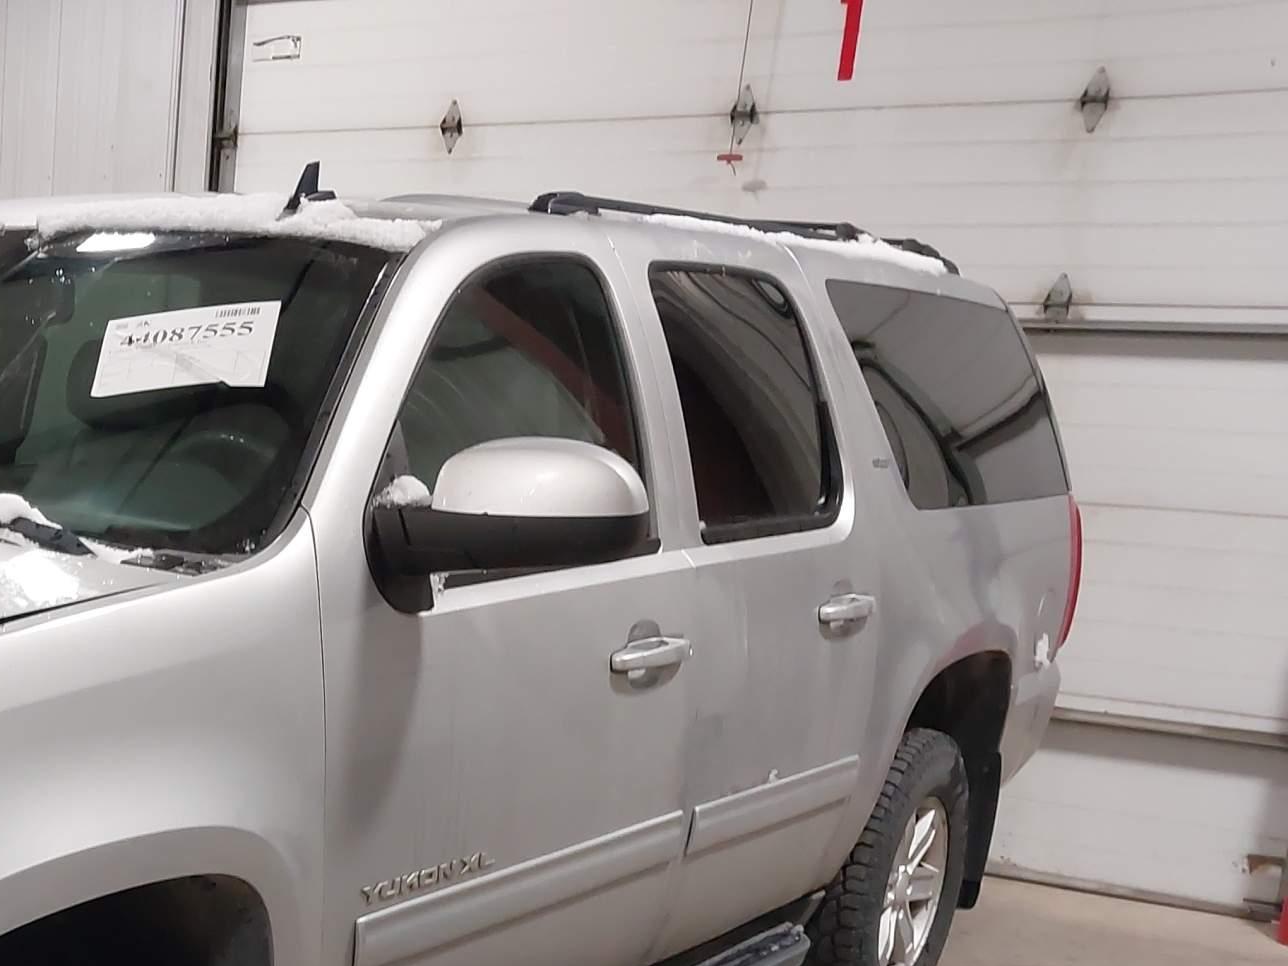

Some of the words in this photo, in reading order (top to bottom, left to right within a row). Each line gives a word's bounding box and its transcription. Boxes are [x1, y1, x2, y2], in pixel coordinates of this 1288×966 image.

[836, 0, 864, 81] 1
[119, 320, 255, 348] 44087555
[360, 858, 457, 905] YUKON
[459, 851, 496, 875] XL
